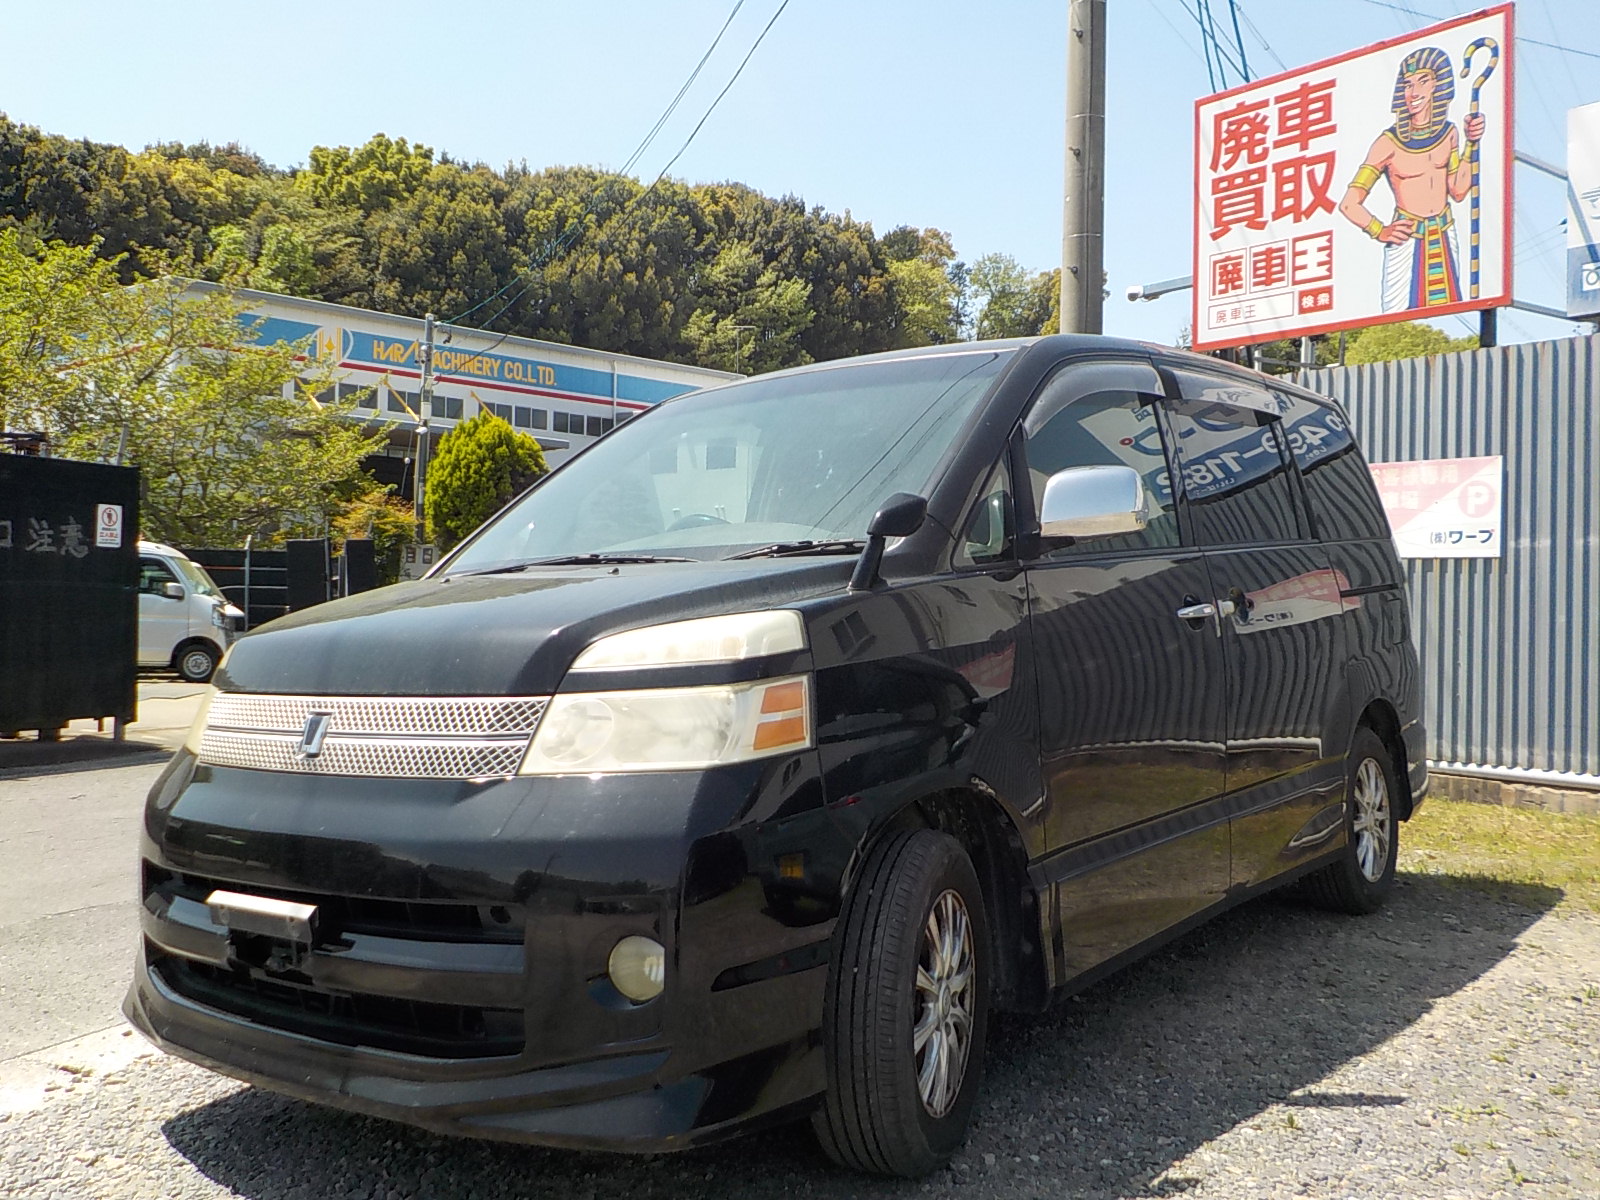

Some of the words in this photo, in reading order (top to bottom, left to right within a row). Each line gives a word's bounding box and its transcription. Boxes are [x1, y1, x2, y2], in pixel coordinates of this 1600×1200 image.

[1209, 78, 1338, 173] 廃車
[1209, 150, 1338, 241] 買取
[432, 350, 502, 377] ACHINERY
[1466, 485, 1490, 515] P
[25, 516, 89, 558] 注意
